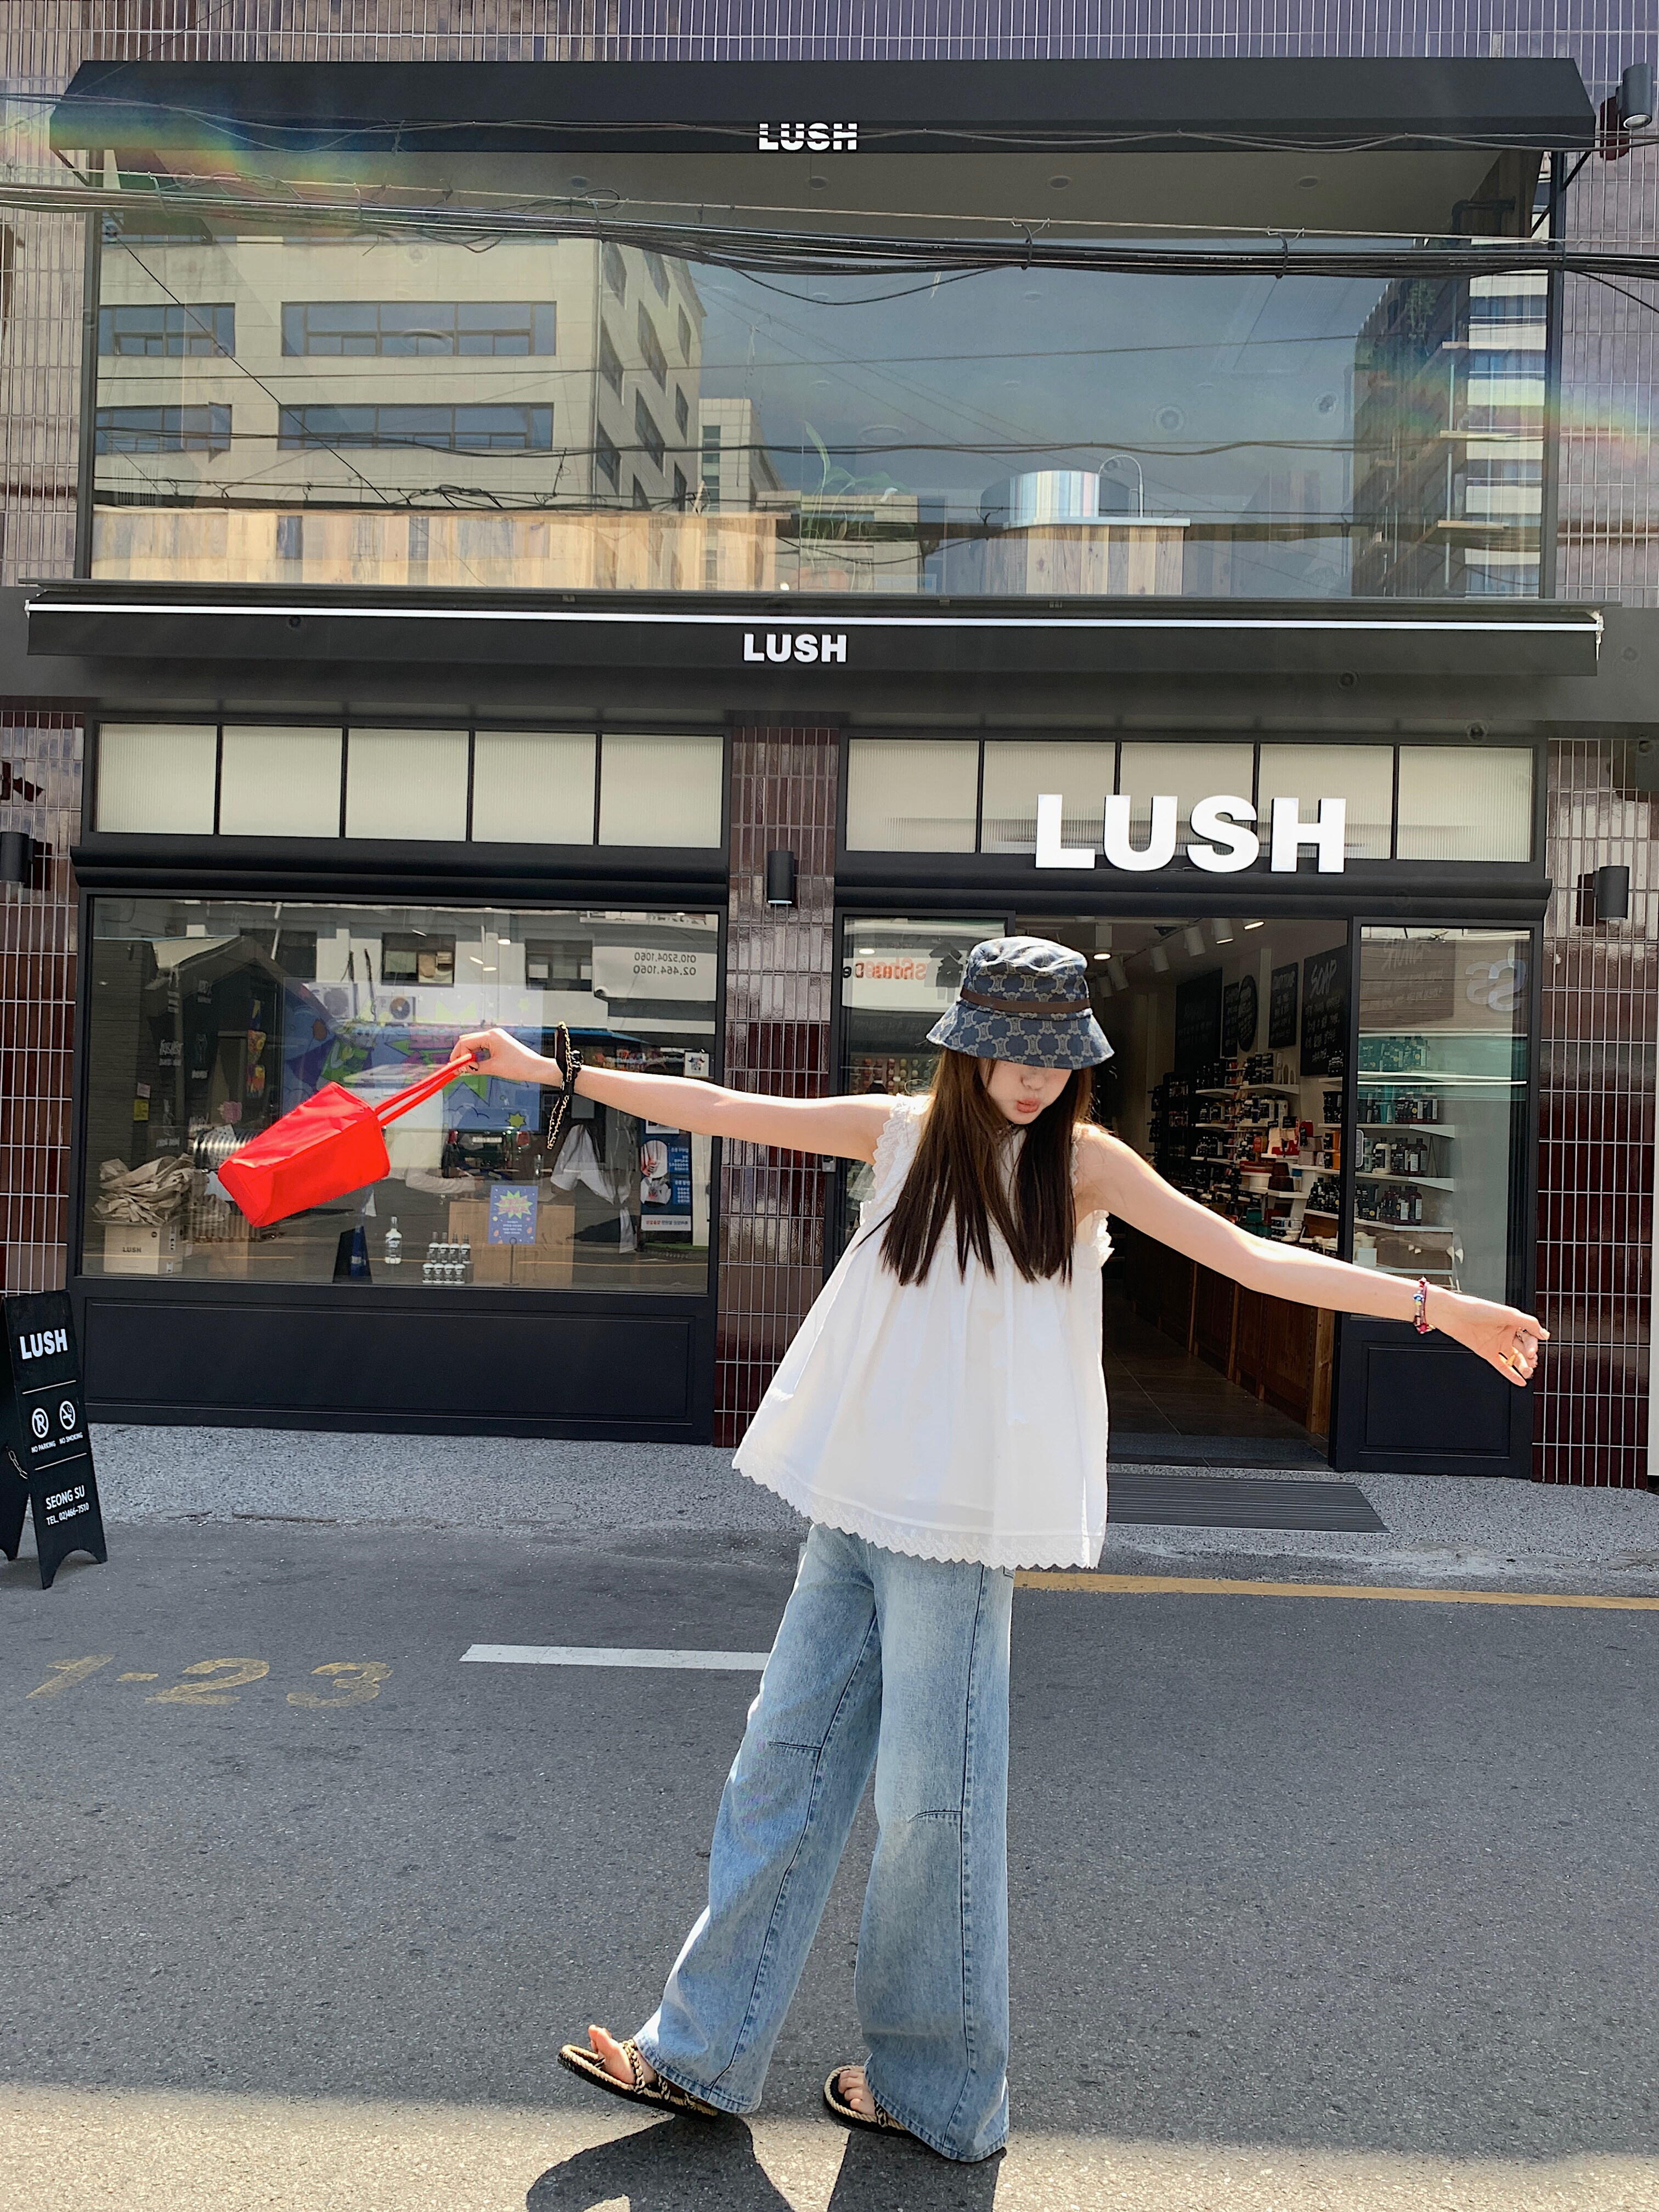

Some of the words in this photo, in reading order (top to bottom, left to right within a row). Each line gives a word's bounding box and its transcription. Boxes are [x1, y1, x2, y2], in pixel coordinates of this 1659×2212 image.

[758, 122, 857, 151] LUSH
[743, 633, 847, 663] LUSH
[1035, 794, 1346, 873] LUSH
[1309, 958, 1338, 1000] SOAP
[20, 1328, 68, 1360] LUSH
[38, 1441, 56, 1451] PARKING
[66, 1432, 83, 1442] SMOKING
[46, 1489, 74, 1510] SEONG
[74, 1485, 85, 1499] SU
